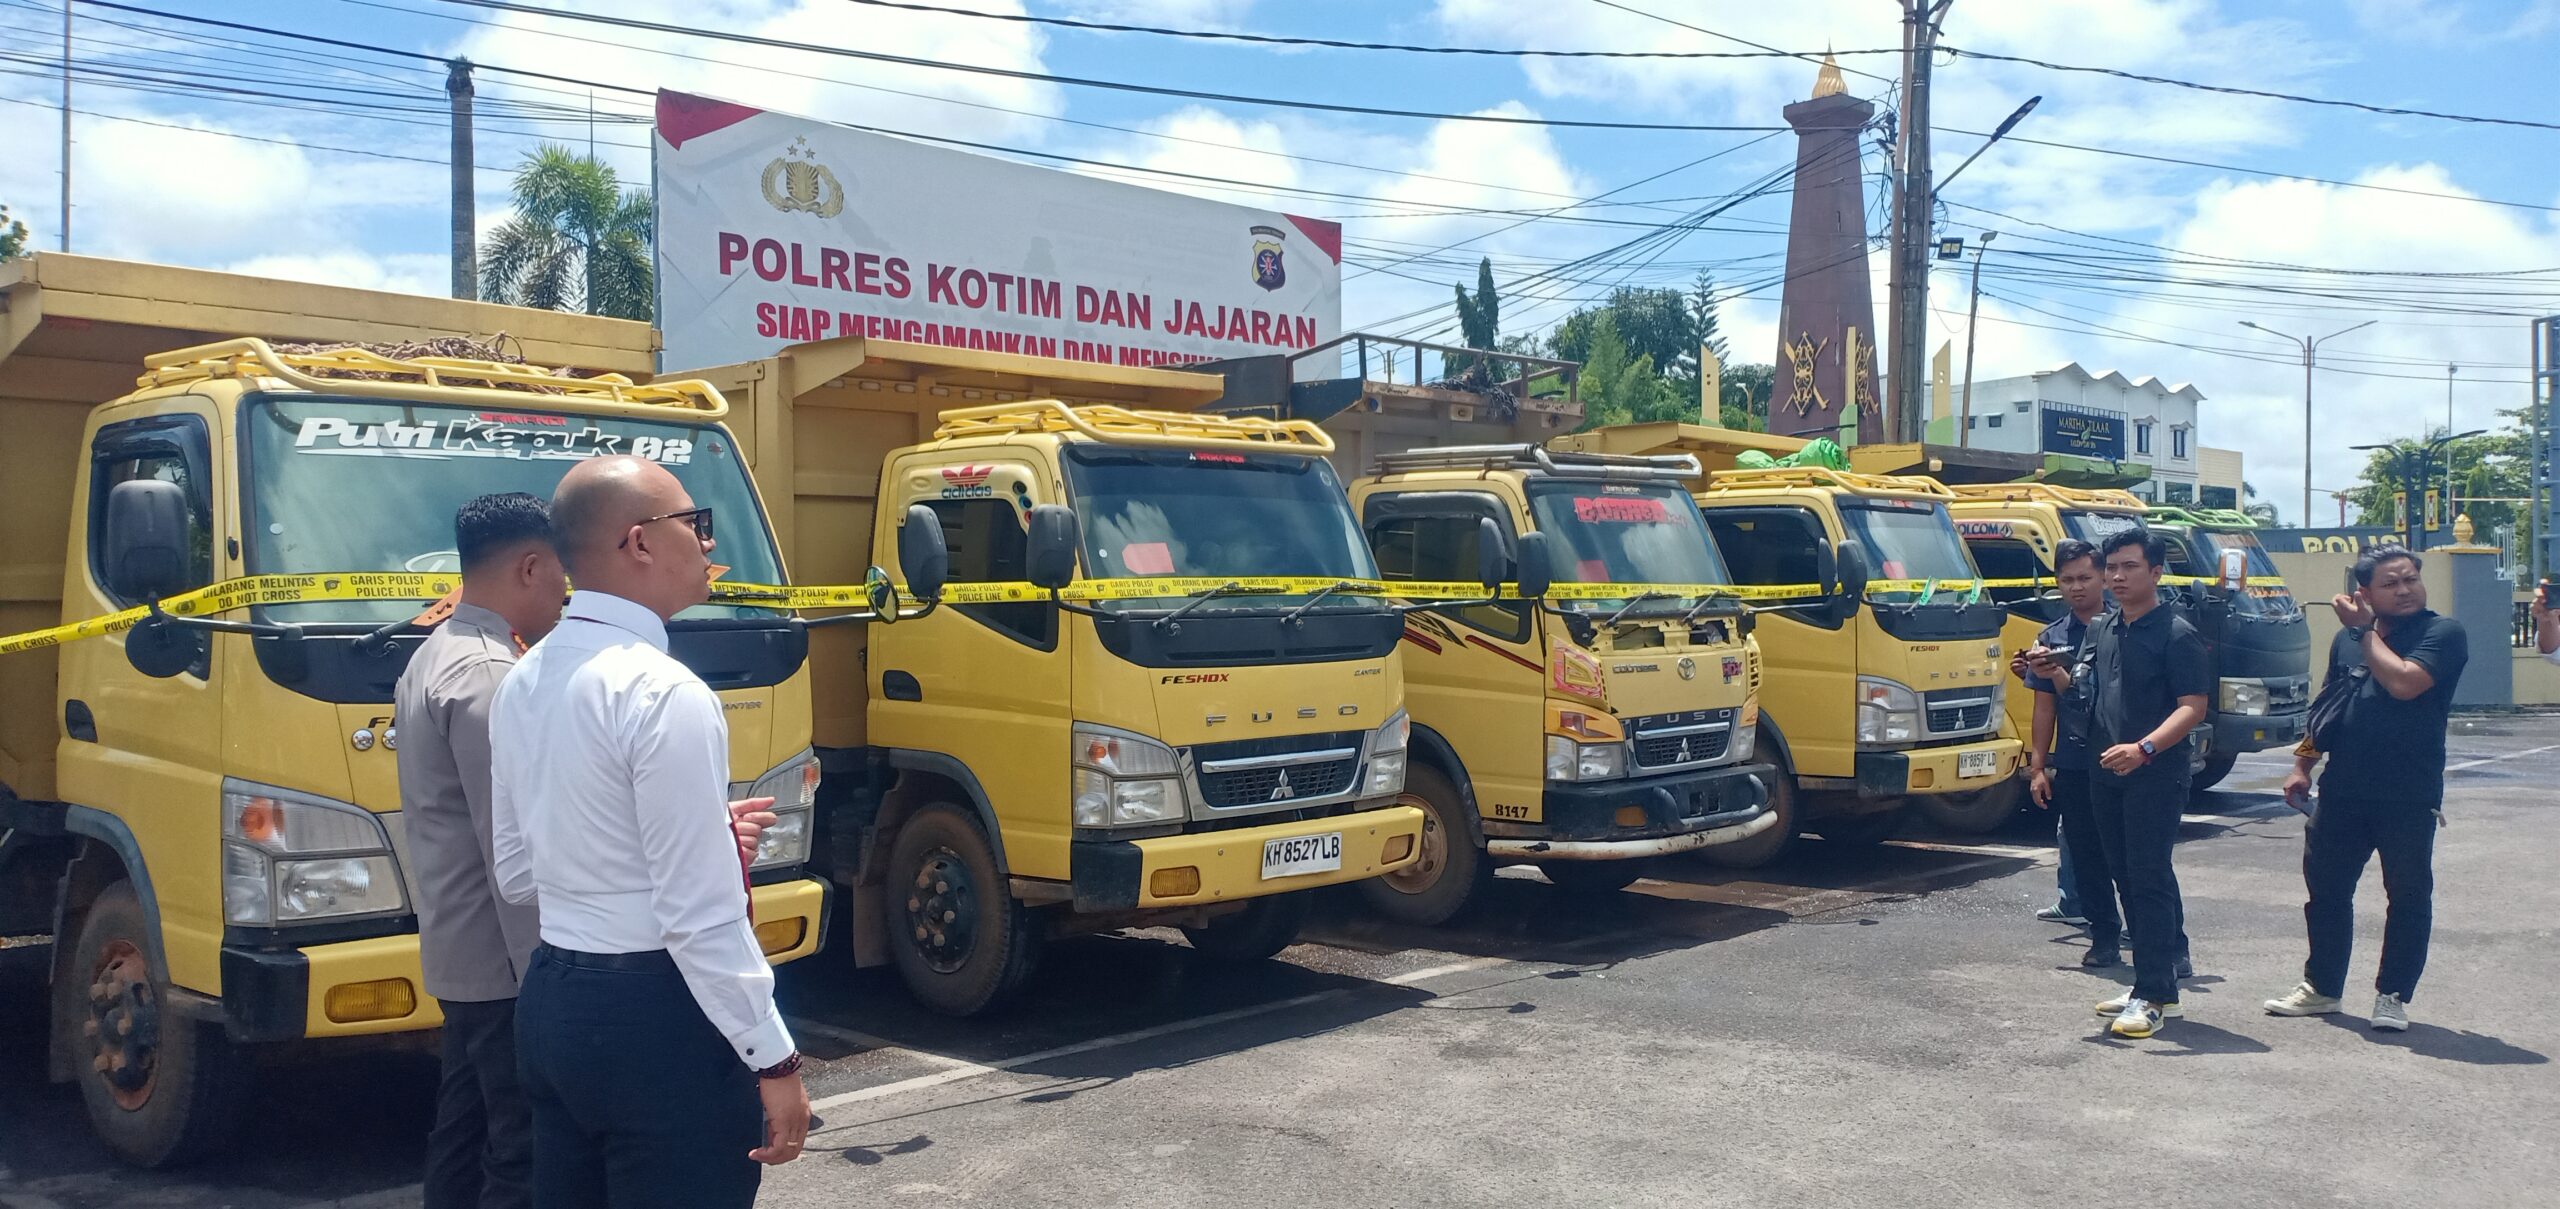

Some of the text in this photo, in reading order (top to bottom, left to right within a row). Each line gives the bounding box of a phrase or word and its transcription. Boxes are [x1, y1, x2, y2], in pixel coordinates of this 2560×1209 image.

[719, 232, 1316, 349] POLRES KOTIM DAN JAJARAN
[756, 303, 831, 341] SIAP
[839, 312, 1056, 358] MENGAMANKAN
[1064, 340, 1112, 364] DAN
[942, 485, 992, 499] adidas
[1957, 523, 1999, 535] OLCOM
[2301, 535, 2406, 553] POL
[350, 575, 425, 586] GARIS POLISI
[1110, 579, 1154, 588] GARIS POLISI
[1243, 578, 1260, 586] GARIS
[203, 576, 316, 599] DILARANG MELINTAS
[356, 586, 423, 598] POLICE LINE
[800, 588, 829, 598] POLISI
[953, 585, 977, 593] GARIS
[1115, 588, 1154, 597] POLICE LINE
[218, 589, 301, 608] DO NOT CROSS
[958, 592, 1002, 602] POLICE LINE
[1063, 591, 1086, 599] CROSS
[23, 635, 58, 650] CROSS
[1161, 673, 1229, 685] FESHDX
[722, 700, 762, 710] ANTER
[1206, 704, 1358, 727] FUSO
[1639, 709, 1732, 728] FUSO
[1495, 803, 1529, 819] 8147
[1265, 836, 1340, 868] KH 8527 LB
